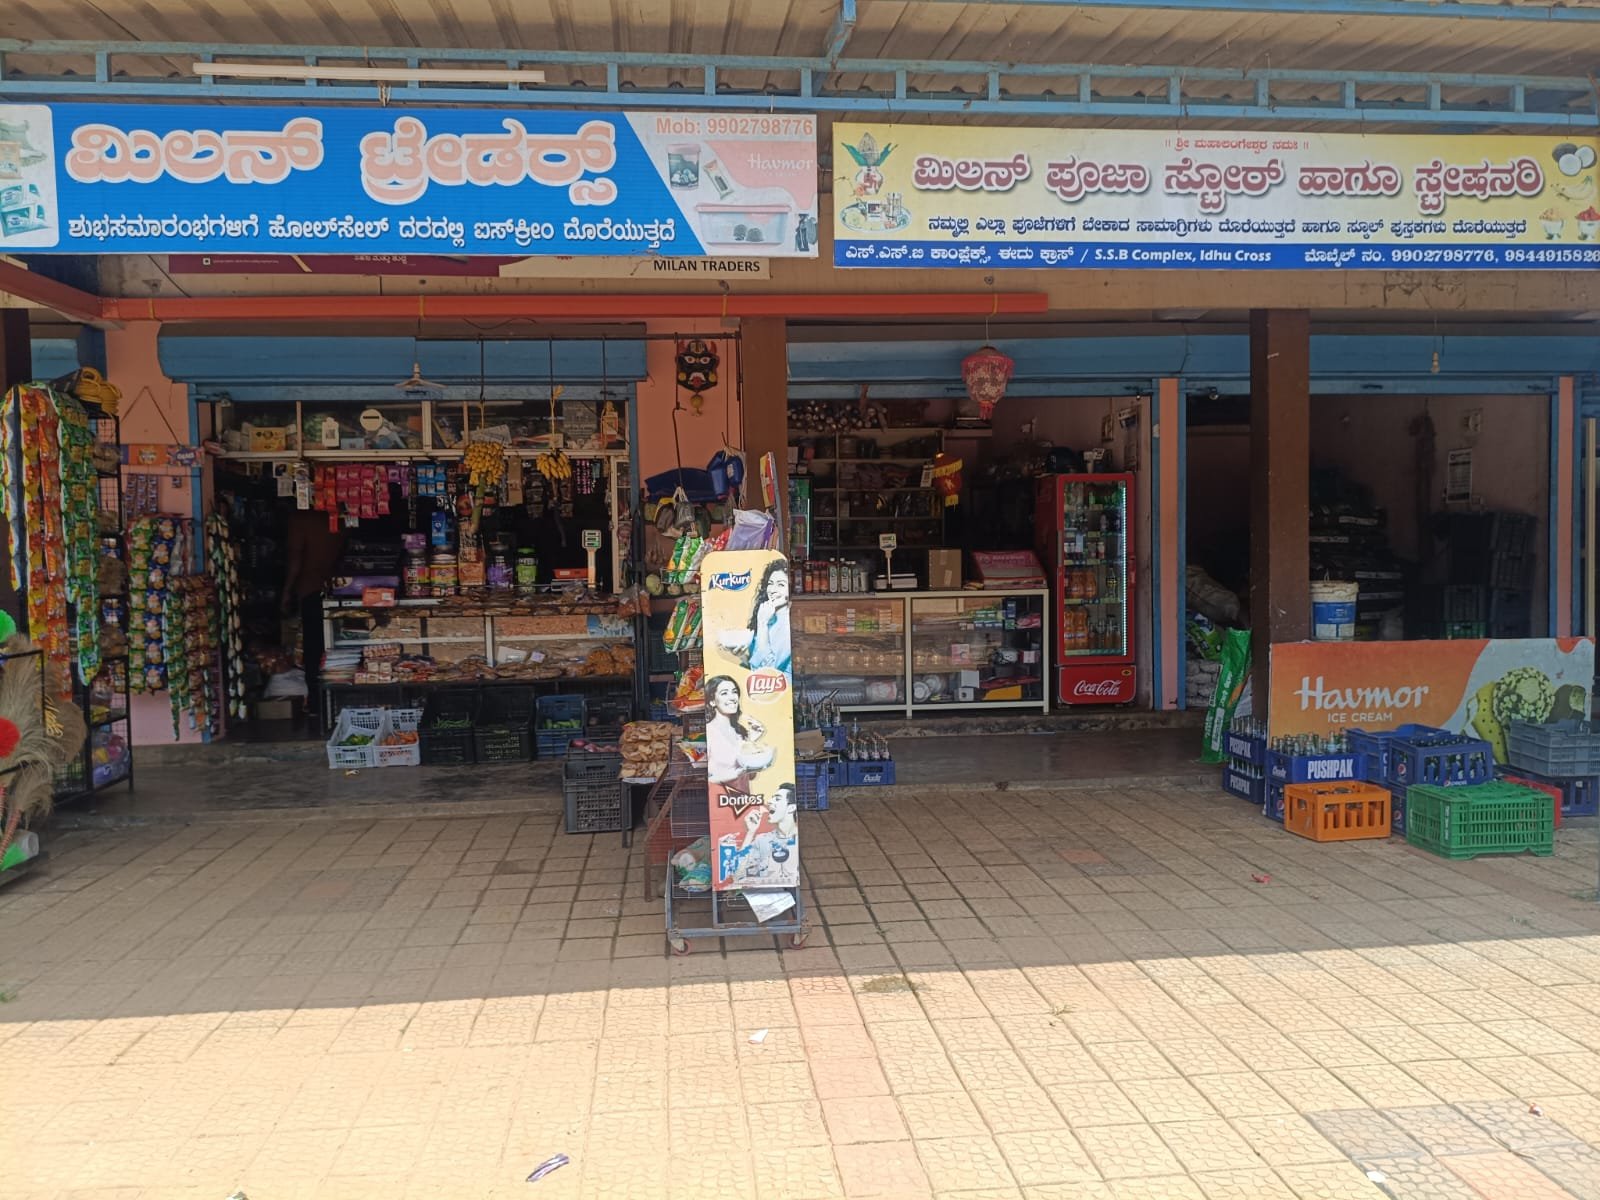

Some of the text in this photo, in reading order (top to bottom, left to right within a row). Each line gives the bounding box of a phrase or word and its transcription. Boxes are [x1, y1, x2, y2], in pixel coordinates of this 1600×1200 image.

[656, 118, 813, 135] Mob: 9902798776
[65, 117, 324, 184] ಮಿಲನ್
[1175, 138, 1190, 152] ಶ್ರೀ
[747, 152, 814, 171] Havmor
[912, 153, 1541, 211] ಮಿಲನ್ ಪೂಜಾ ಸ್ಟೋರ್ ಹಾಗೂ ಸ್ಟೇಷನರಿ
[68, 213, 259, 242] ಶುಭಸಮಾರಂಭಗಳಿಗೆ
[399, 216, 465, 247] ದರದಲ್ಲಿ
[564, 218, 675, 248] ದೊರೆಯುತ್ತದೆ
[928, 216, 1526, 239] ನಮ್ಮಲ್ಲಿ ಎಲ್ಲಾ ಪೂಜೆಗಳಿಗೆ ಬೇಕಾದ ಸಾಮಾಗ್ರಿಗಳು ದೊರೆಯುತ್ತದೆ ಹಾಗೂ ಸ್ಕೂಲ್ ಪುಸ್ತಕಗಳು ದೊರೆಯುತ್ತದೆ
[1040, 246, 1075, 264] ಕ್ರಾಸ್
[1095, 249, 1129, 261] S.S.B
[1132, 249, 1196, 263] Complex,
[1200, 249, 1233, 261] Idhu
[1235, 250, 1271, 261] Cross
[1304, 249, 1356, 267] ಮೊಬೈಲ್
[1391, 250, 1499, 264] 9902798776,
[1505, 250, 1600, 262] 9844915826
[654, 260, 760, 272] MILAN TRADERS
[1292, 676, 1430, 711] Havmor
[1327, 712, 1393, 723] ICE CREAM
[1307, 758, 1353, 780] PUSHPAK
[719, 793, 764, 807] Doritos
